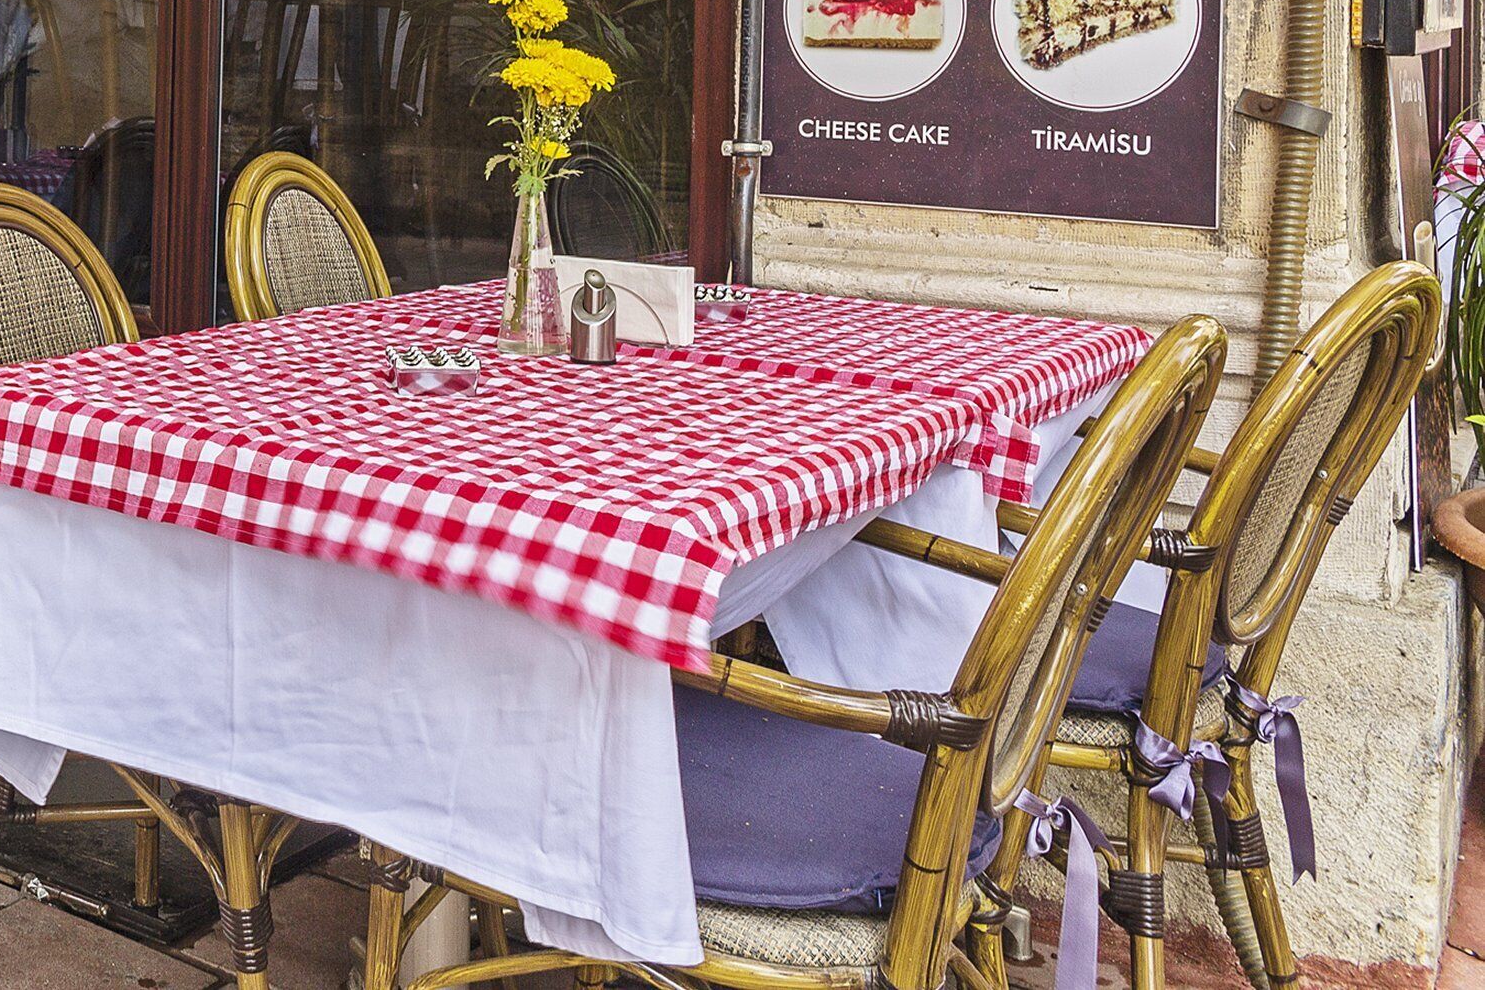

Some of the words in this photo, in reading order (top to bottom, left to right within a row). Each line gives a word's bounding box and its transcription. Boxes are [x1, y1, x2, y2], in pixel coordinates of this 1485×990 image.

[798, 118, 882, 143] CHEESE
[888, 122, 951, 147] CAKE
[1031, 125, 1153, 157] TİRAMİSU
